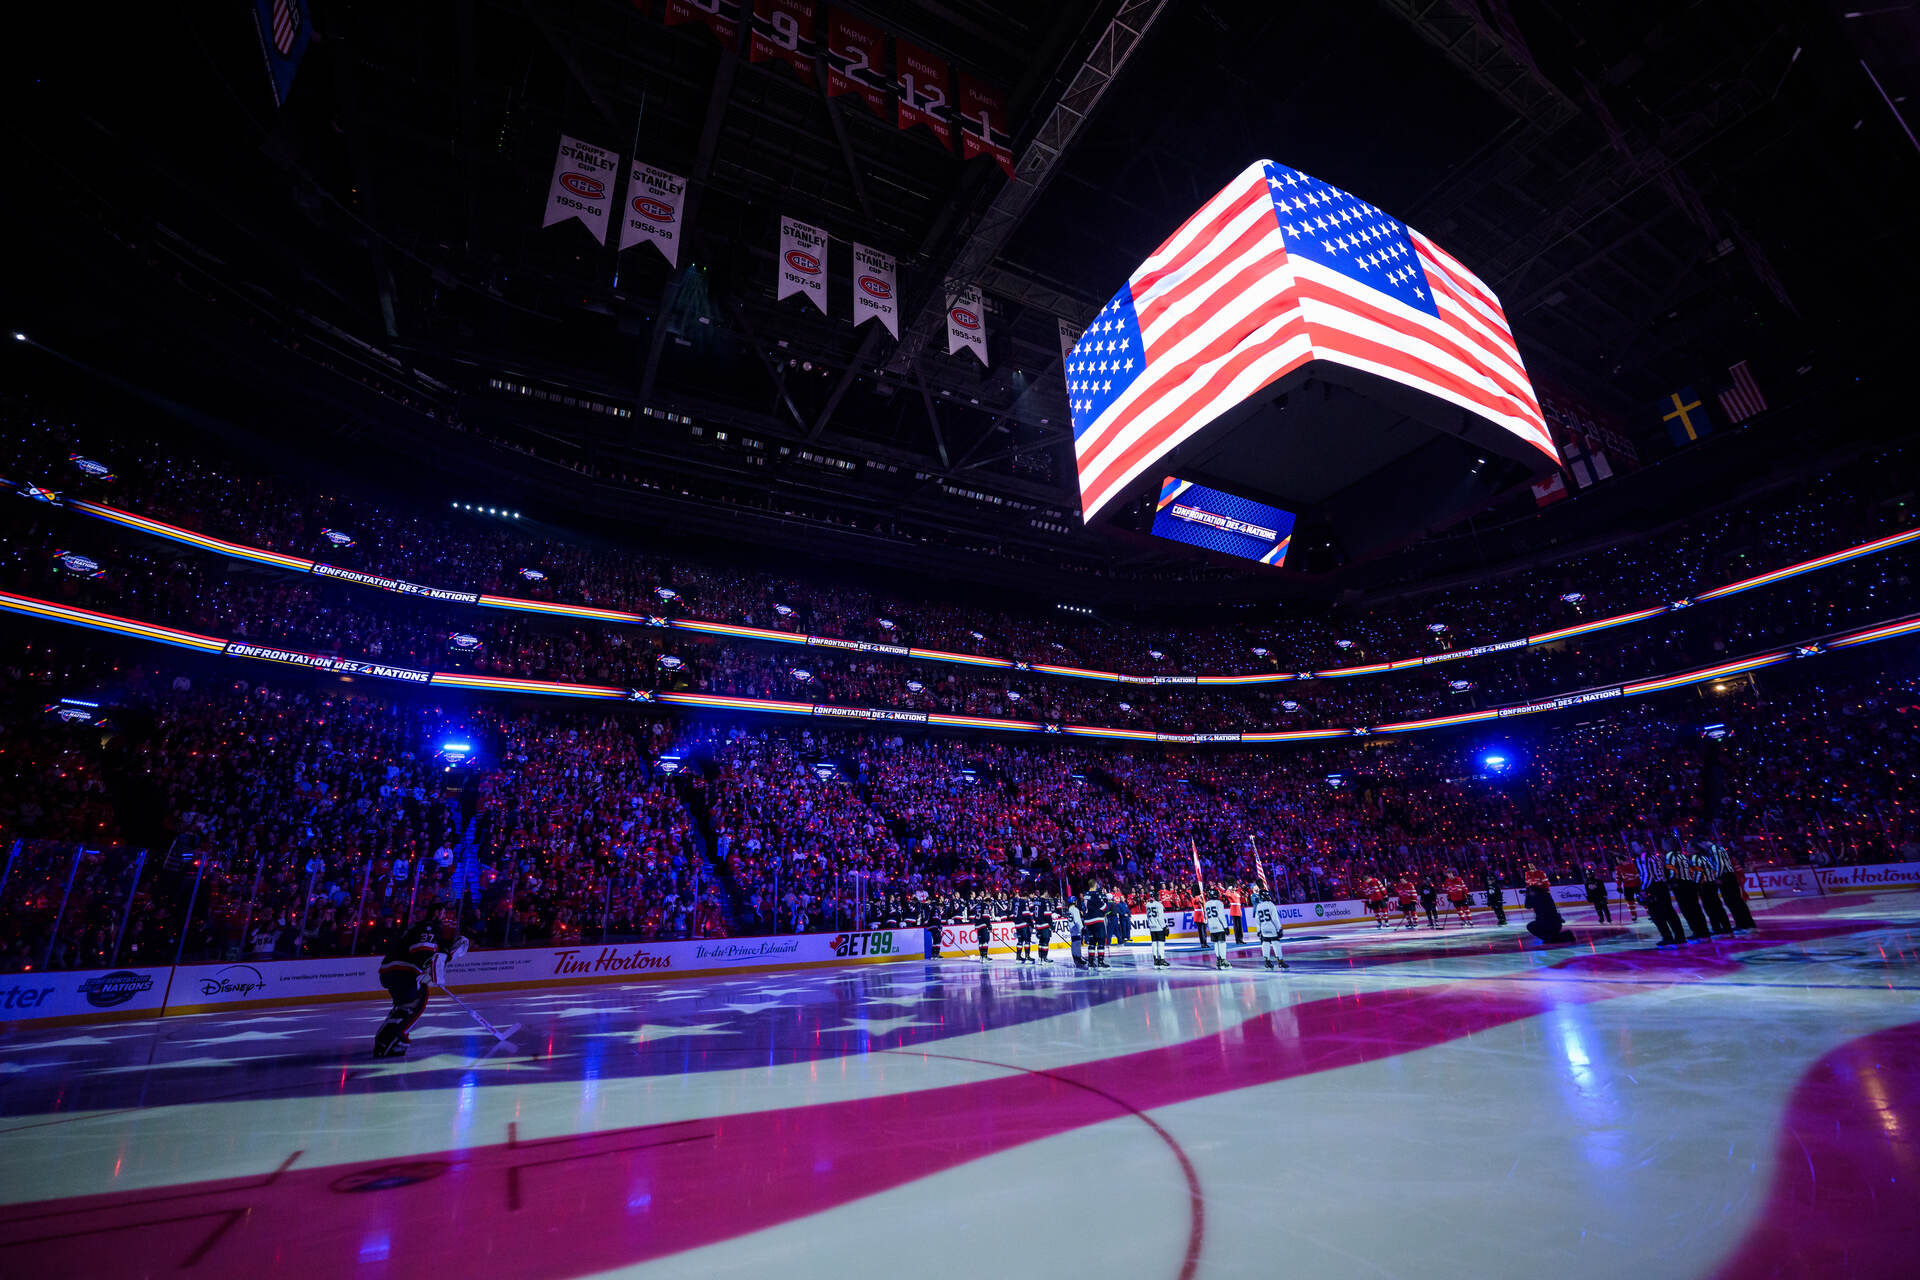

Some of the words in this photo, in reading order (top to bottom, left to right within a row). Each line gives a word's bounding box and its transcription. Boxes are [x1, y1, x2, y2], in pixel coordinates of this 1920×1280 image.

[771, 11, 798, 51] 9
[840, 24, 873, 46] HARVEY
[845, 46, 869, 87] 2
[907, 57, 939, 79] MOORE
[901, 72, 949, 123] 12
[978, 110, 995, 145] 1
[561, 145, 616, 171] STANLEY
[575, 142, 606, 157] COUPE
[578, 162, 596, 172] CUP
[646, 167, 674, 181] COUPE
[633, 170, 684, 195] STANLEY
[648, 187, 666, 197] CUP
[556, 196, 602, 217] 1959-60
[630, 220, 673, 240] 1958-59
[783, 225, 826, 248] STANLEY
[793, 222, 817, 235] COUPE
[797, 240, 812, 249] CUP
[864, 248, 886, 260] COUPE
[855, 251, 895, 273] STANLEY
[868, 265, 882, 274] CUP
[785, 272, 821, 290] 1957-58
[859, 297, 892, 313] 1956-57
[951, 328, 982, 344] 1955-56
[1171, 505, 1226, 527] CONFRONTATION
[1225, 519, 1240, 530] DES
[1246, 526, 1277, 540] NATIONS
[313, 564, 398, 588] CONFRONTATION
[399, 583, 418, 593] DES
[430, 590, 477, 602] NATIONS
[808, 637, 858, 649] CONFRONTATION
[879, 646, 908, 655] NATIONS
[1424, 650, 1473, 663] CONFRONTATION
[1495, 639, 1527, 651] NATIONS
[226, 644, 332, 668] CONFRONTATION
[333, 661, 358, 672] DES
[373, 666, 429, 682] NATIONS
[1499, 700, 1557, 716] CONFRONTATION
[1583, 688, 1621, 702] NATIONS
[814, 706, 871, 717] CONFRONTATION
[872, 711, 885, 719] DES
[894, 712, 927, 721] NATIONS
[1817, 869, 1849, 885] Tim
[1147, 907, 1157, 918] 25
[1206, 906, 1218, 918] 25
[1258, 909, 1272, 922] 25
[1280, 908, 1303, 919] NDUEL
[836, 931, 893, 957] BET99
[960, 927, 1017, 945] ROERS
[554, 950, 591, 975] Tim
[594, 947, 672, 972] Hortons
[102, 982, 150, 993] NATIONS
[199, 977, 266, 997] Disney+
[0, 985, 54, 1010] ter
